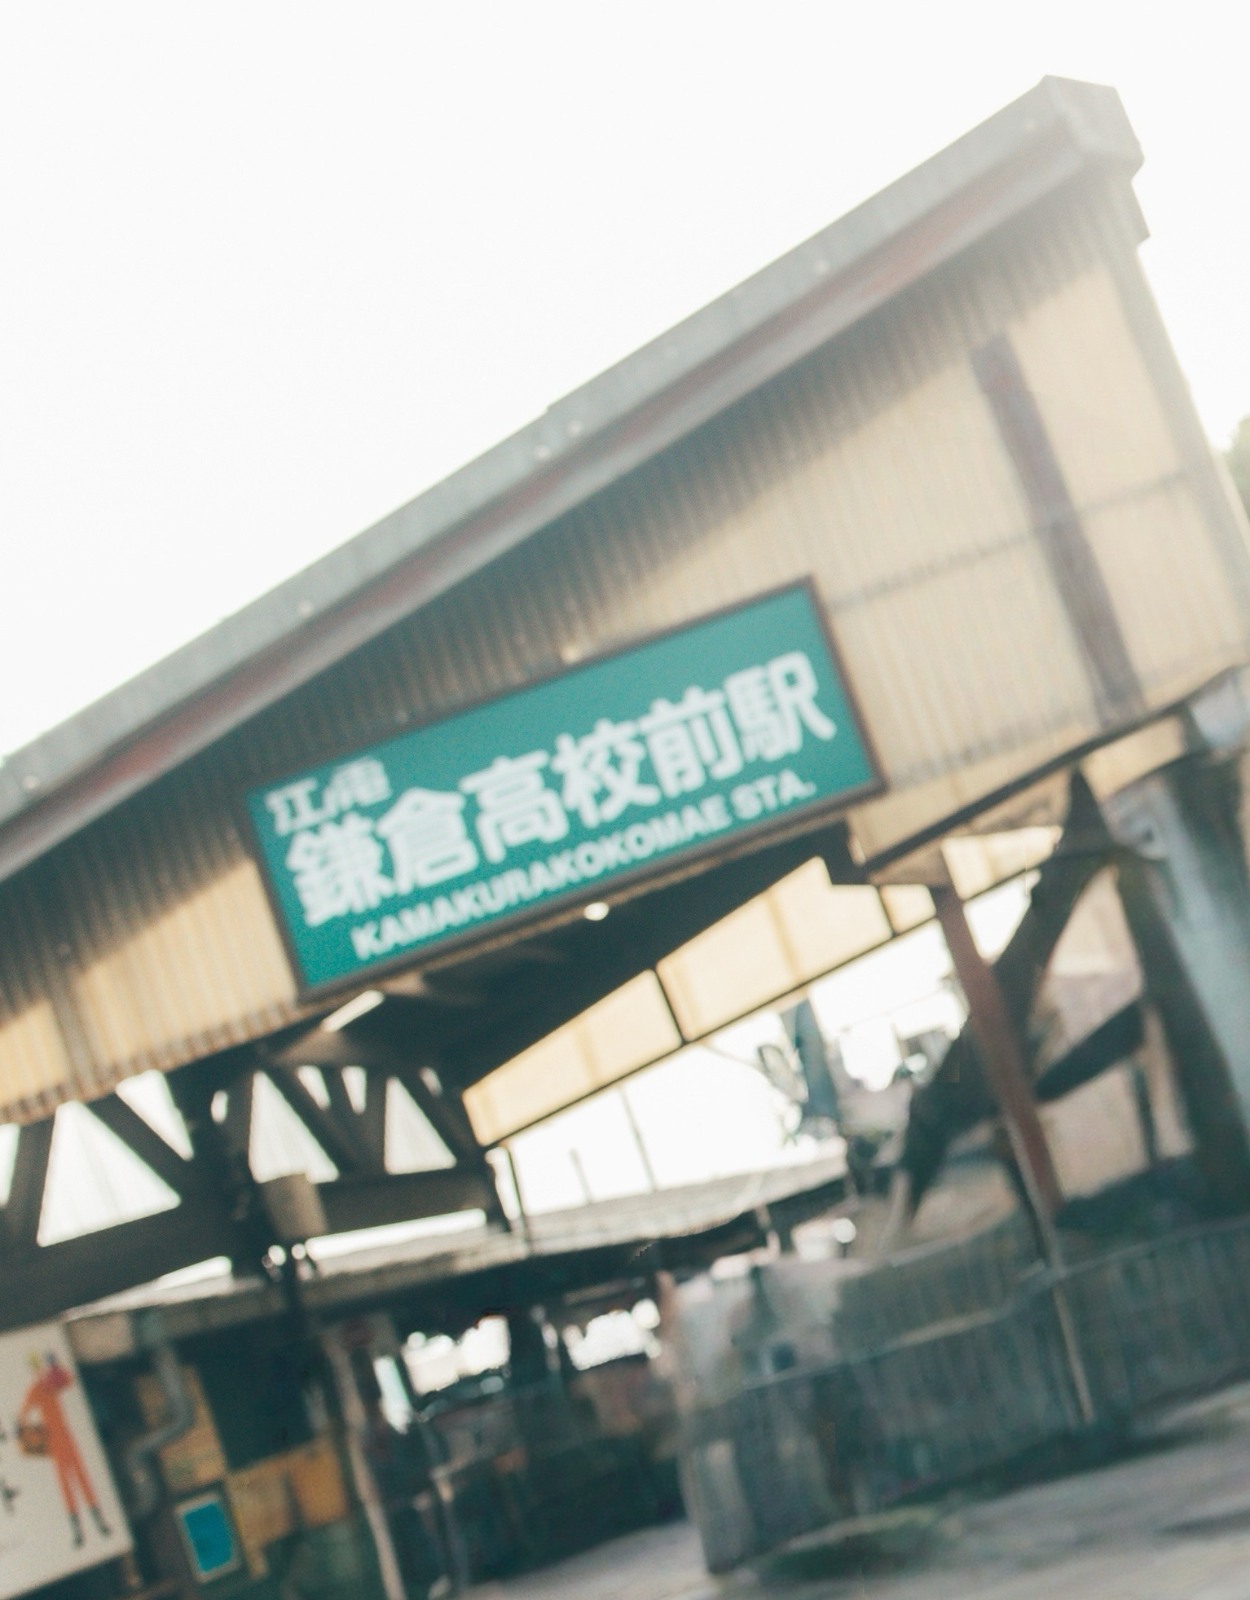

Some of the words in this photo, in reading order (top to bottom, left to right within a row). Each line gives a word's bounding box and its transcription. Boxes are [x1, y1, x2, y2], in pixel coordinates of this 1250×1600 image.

[286, 651, 836, 927] 鎌倉高校前駅
[351, 796, 731, 959] KAMAKURAKOKOMAE
[734, 770, 816, 820] STA.
